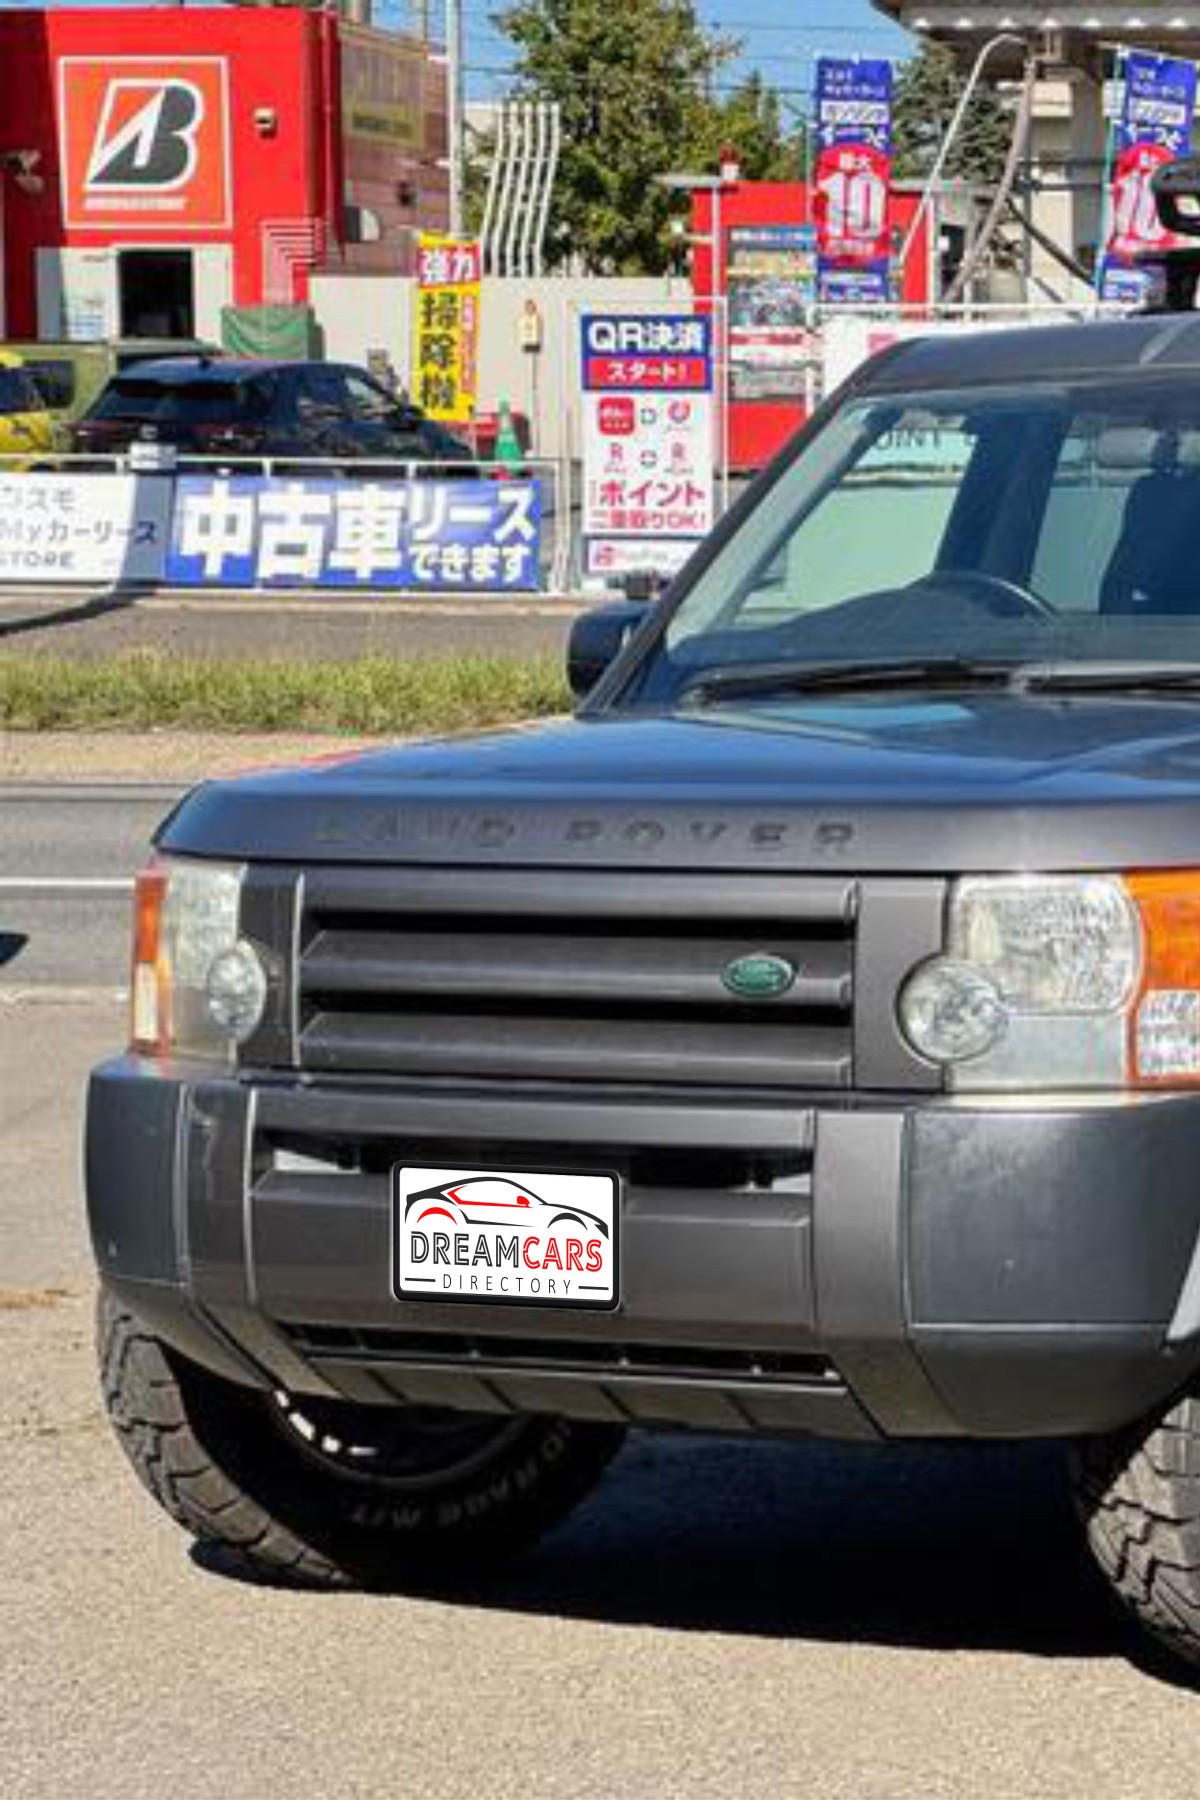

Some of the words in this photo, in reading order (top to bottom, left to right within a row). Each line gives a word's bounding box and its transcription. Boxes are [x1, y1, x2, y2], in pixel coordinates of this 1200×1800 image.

[818, 172, 886, 238] 10
[409, 483, 538, 542] リース
[600, 480, 706, 507] ポイント
[180, 480, 402, 580] 中古車
[408, 544, 532, 582] できます
[565, 818, 857, 853] ROVER
